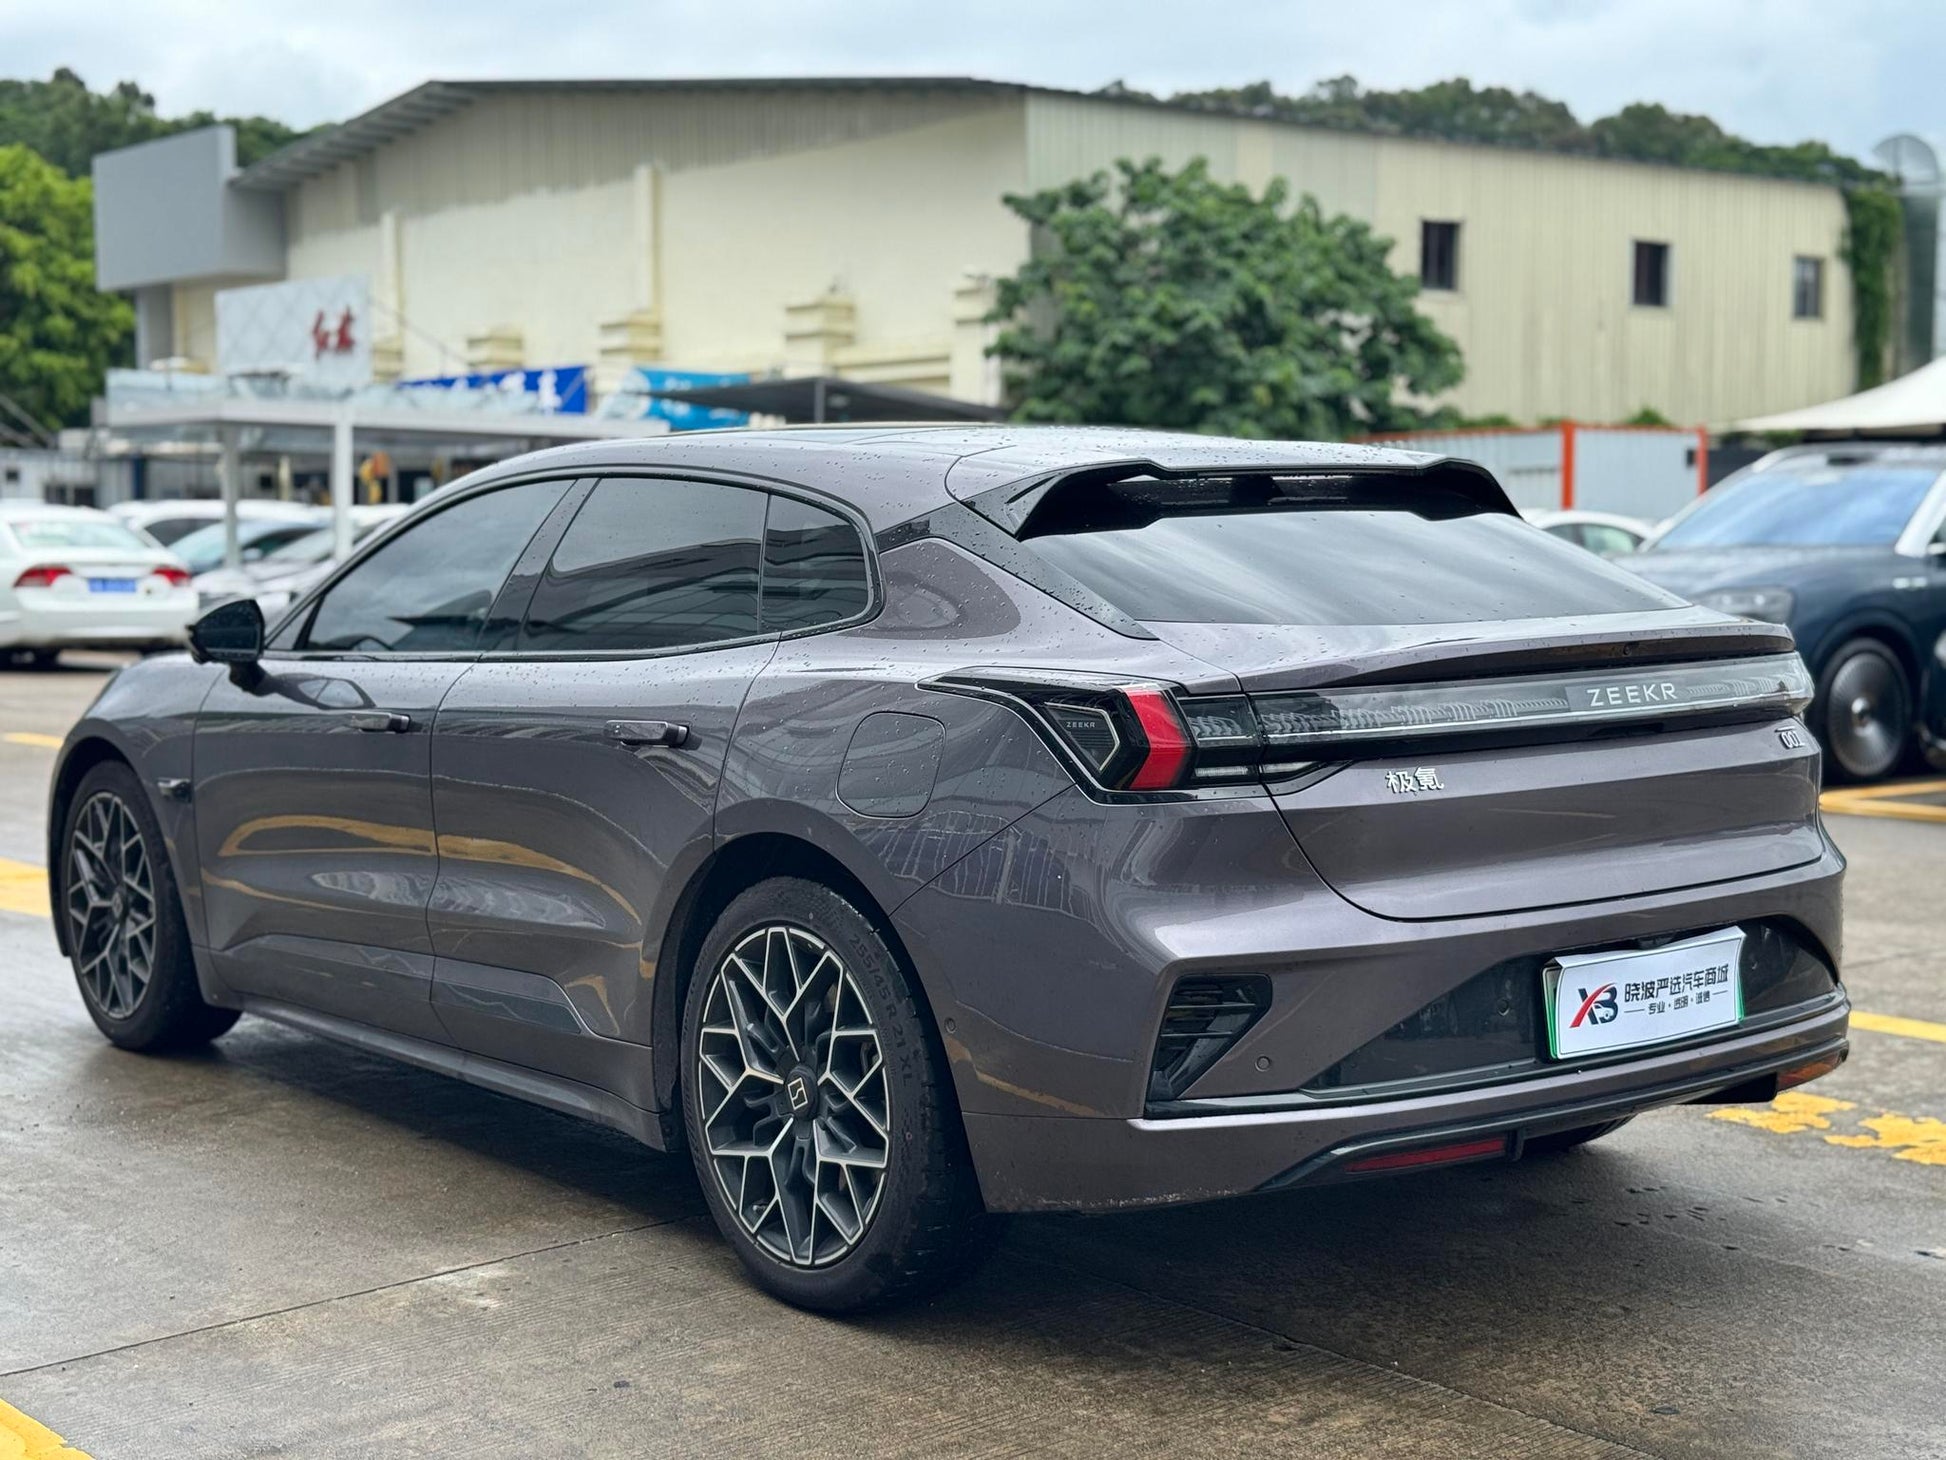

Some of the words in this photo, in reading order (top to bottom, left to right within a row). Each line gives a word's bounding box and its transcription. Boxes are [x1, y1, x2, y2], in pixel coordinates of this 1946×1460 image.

[1586, 682, 1678, 707] ZEEKR
[1779, 729, 1805, 749] 001
[1385, 767, 1445, 794] 极氪
[1624, 963, 1729, 1002] 晓波严选汽车商城
[849, 934, 891, 999] 255/45
[885, 1003, 897, 1020] R
[892, 1023, 906, 1048] 21
[901, 1054, 913, 1086] XL
